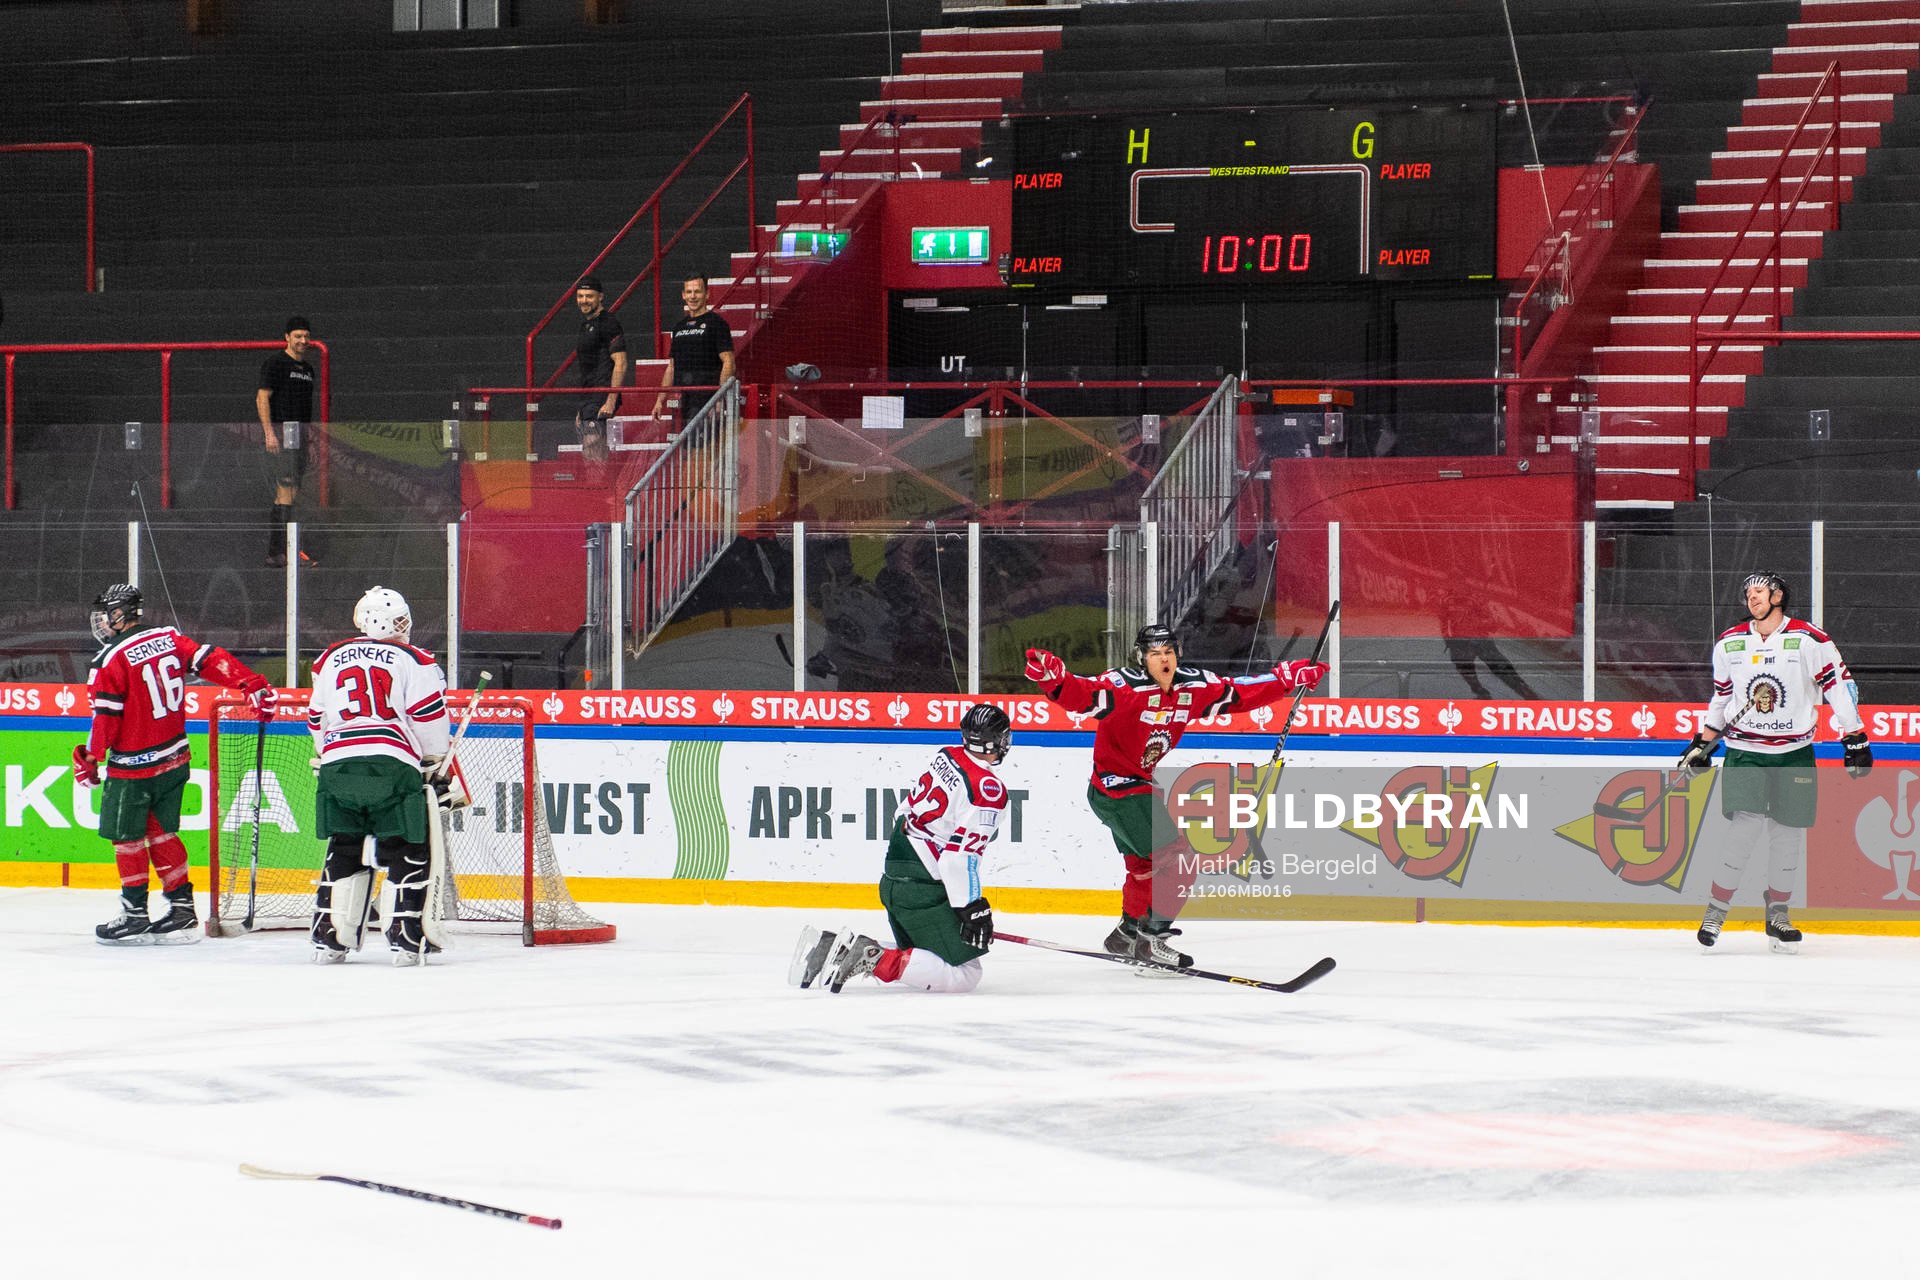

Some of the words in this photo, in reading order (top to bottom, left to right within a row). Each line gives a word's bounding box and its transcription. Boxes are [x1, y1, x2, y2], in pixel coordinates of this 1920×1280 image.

[1127, 128, 1150, 164] H
[1352, 121, 1375, 159] G
[1014, 173, 1063, 189] PLAYER
[1209, 165, 1290, 177] WESTERSTRAND
[1380, 163, 1431, 180] PLAYER
[1202, 233, 1311, 273] 10:00
[1379, 249, 1431, 265] PLAYER
[1013, 257, 1062, 273] PLAYER
[941, 355, 966, 372] UT
[126, 635, 176, 664] SERNEKE
[333, 647, 397, 667] SERNEKE
[141, 654, 185, 719] 16
[336, 665, 399, 721] 30
[580, 696, 697, 719] STRAUSS
[751, 697, 871, 721] STRAUSS
[1292, 704, 1420, 729] STRAUSS
[1481, 706, 1613, 732] STRAUSS
